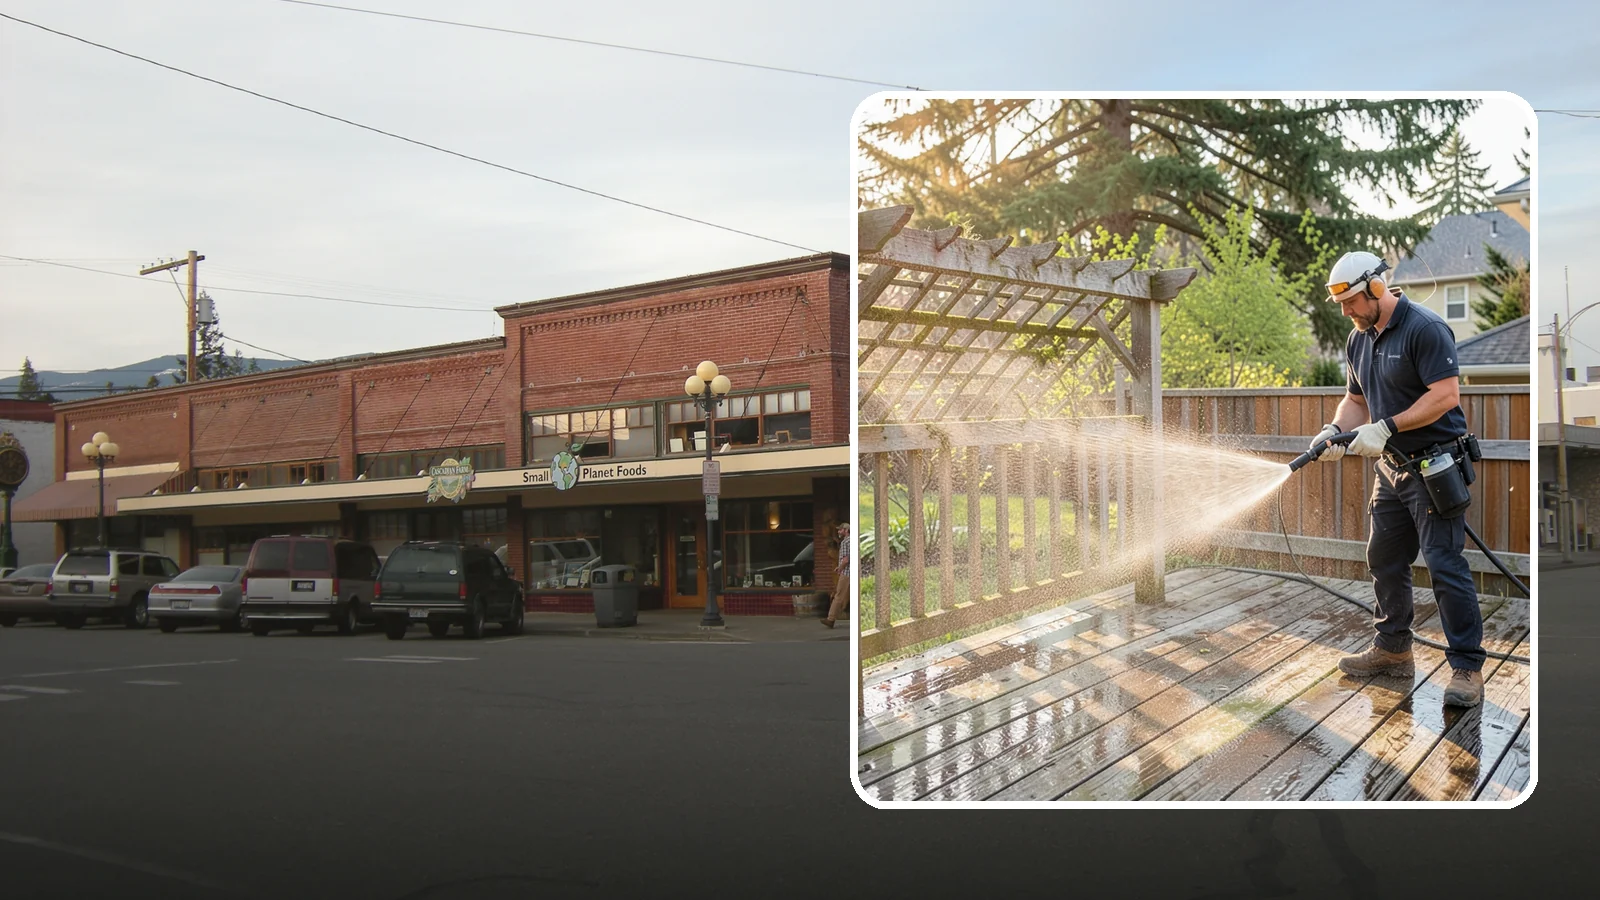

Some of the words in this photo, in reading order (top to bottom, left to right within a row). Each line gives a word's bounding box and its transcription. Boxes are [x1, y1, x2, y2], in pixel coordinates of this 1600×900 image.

[523, 470, 549, 482] Small
[583, 467, 614, 479] Planet
[617, 464, 647, 477] Foods
